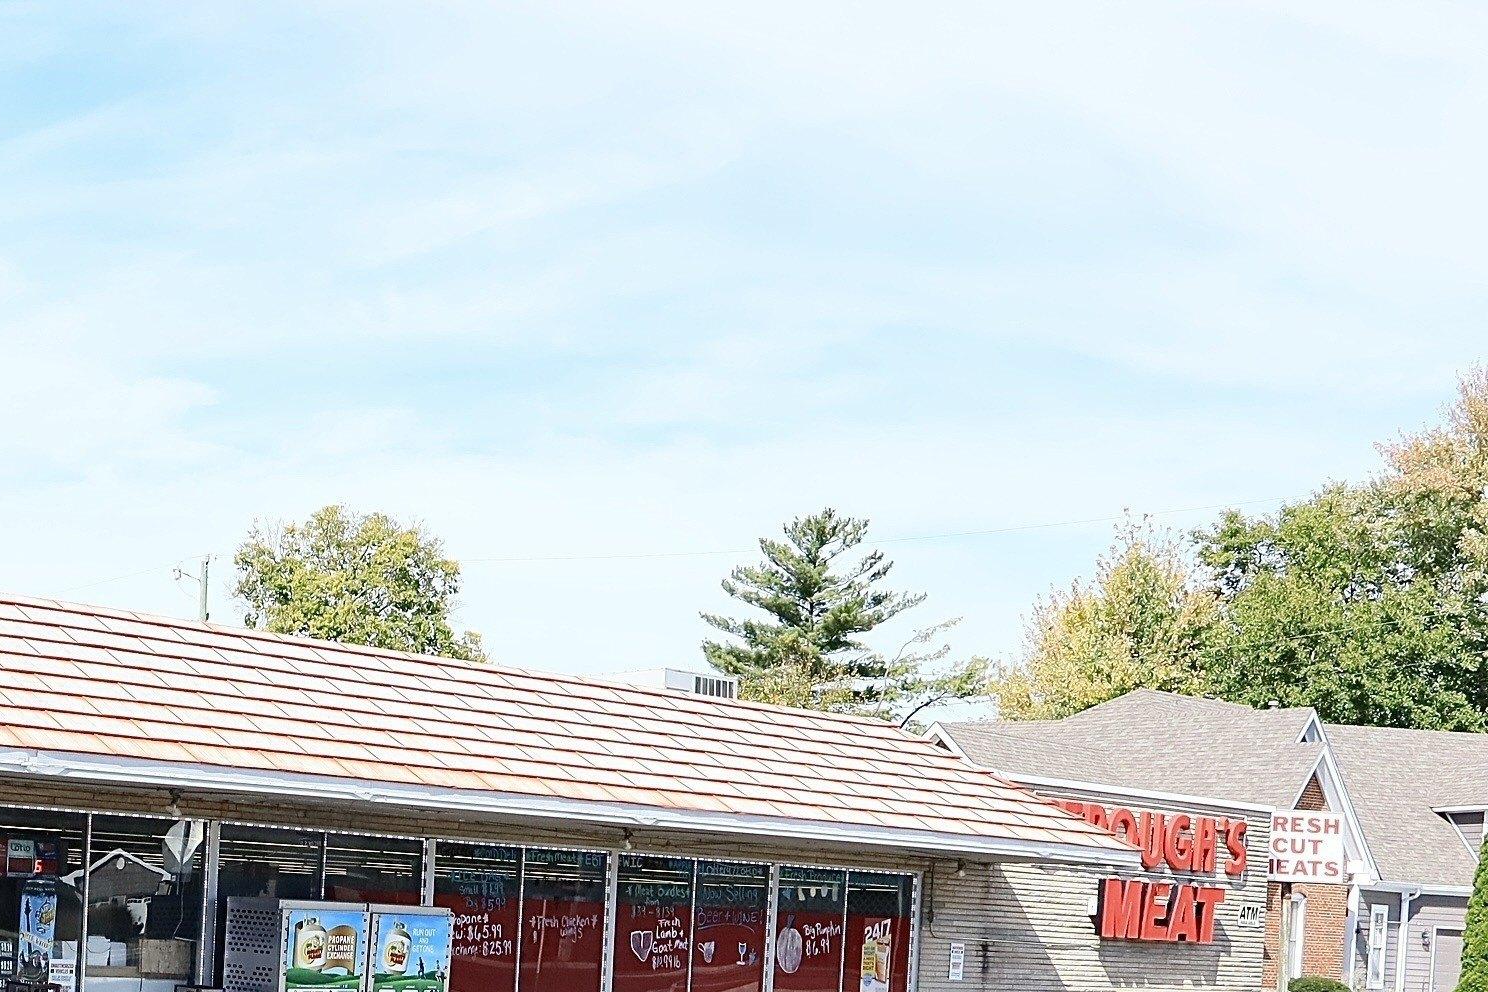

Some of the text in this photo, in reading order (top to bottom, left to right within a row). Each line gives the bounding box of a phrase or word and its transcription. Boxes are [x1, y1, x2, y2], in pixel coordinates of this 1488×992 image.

[1273, 816, 1340, 835] RESH
[1273, 838, 1323, 855] CUT
[34, 859, 43, 873] 6
[1101, 879, 1226, 943] MEAT
[1239, 906, 1259, 920] ATM
[328, 935, 355, 943] PROPANE
[656, 926, 678, 939] Lamb
[652, 940, 673, 953] Goat
[326, 951, 354, 960] EXCHANGE
